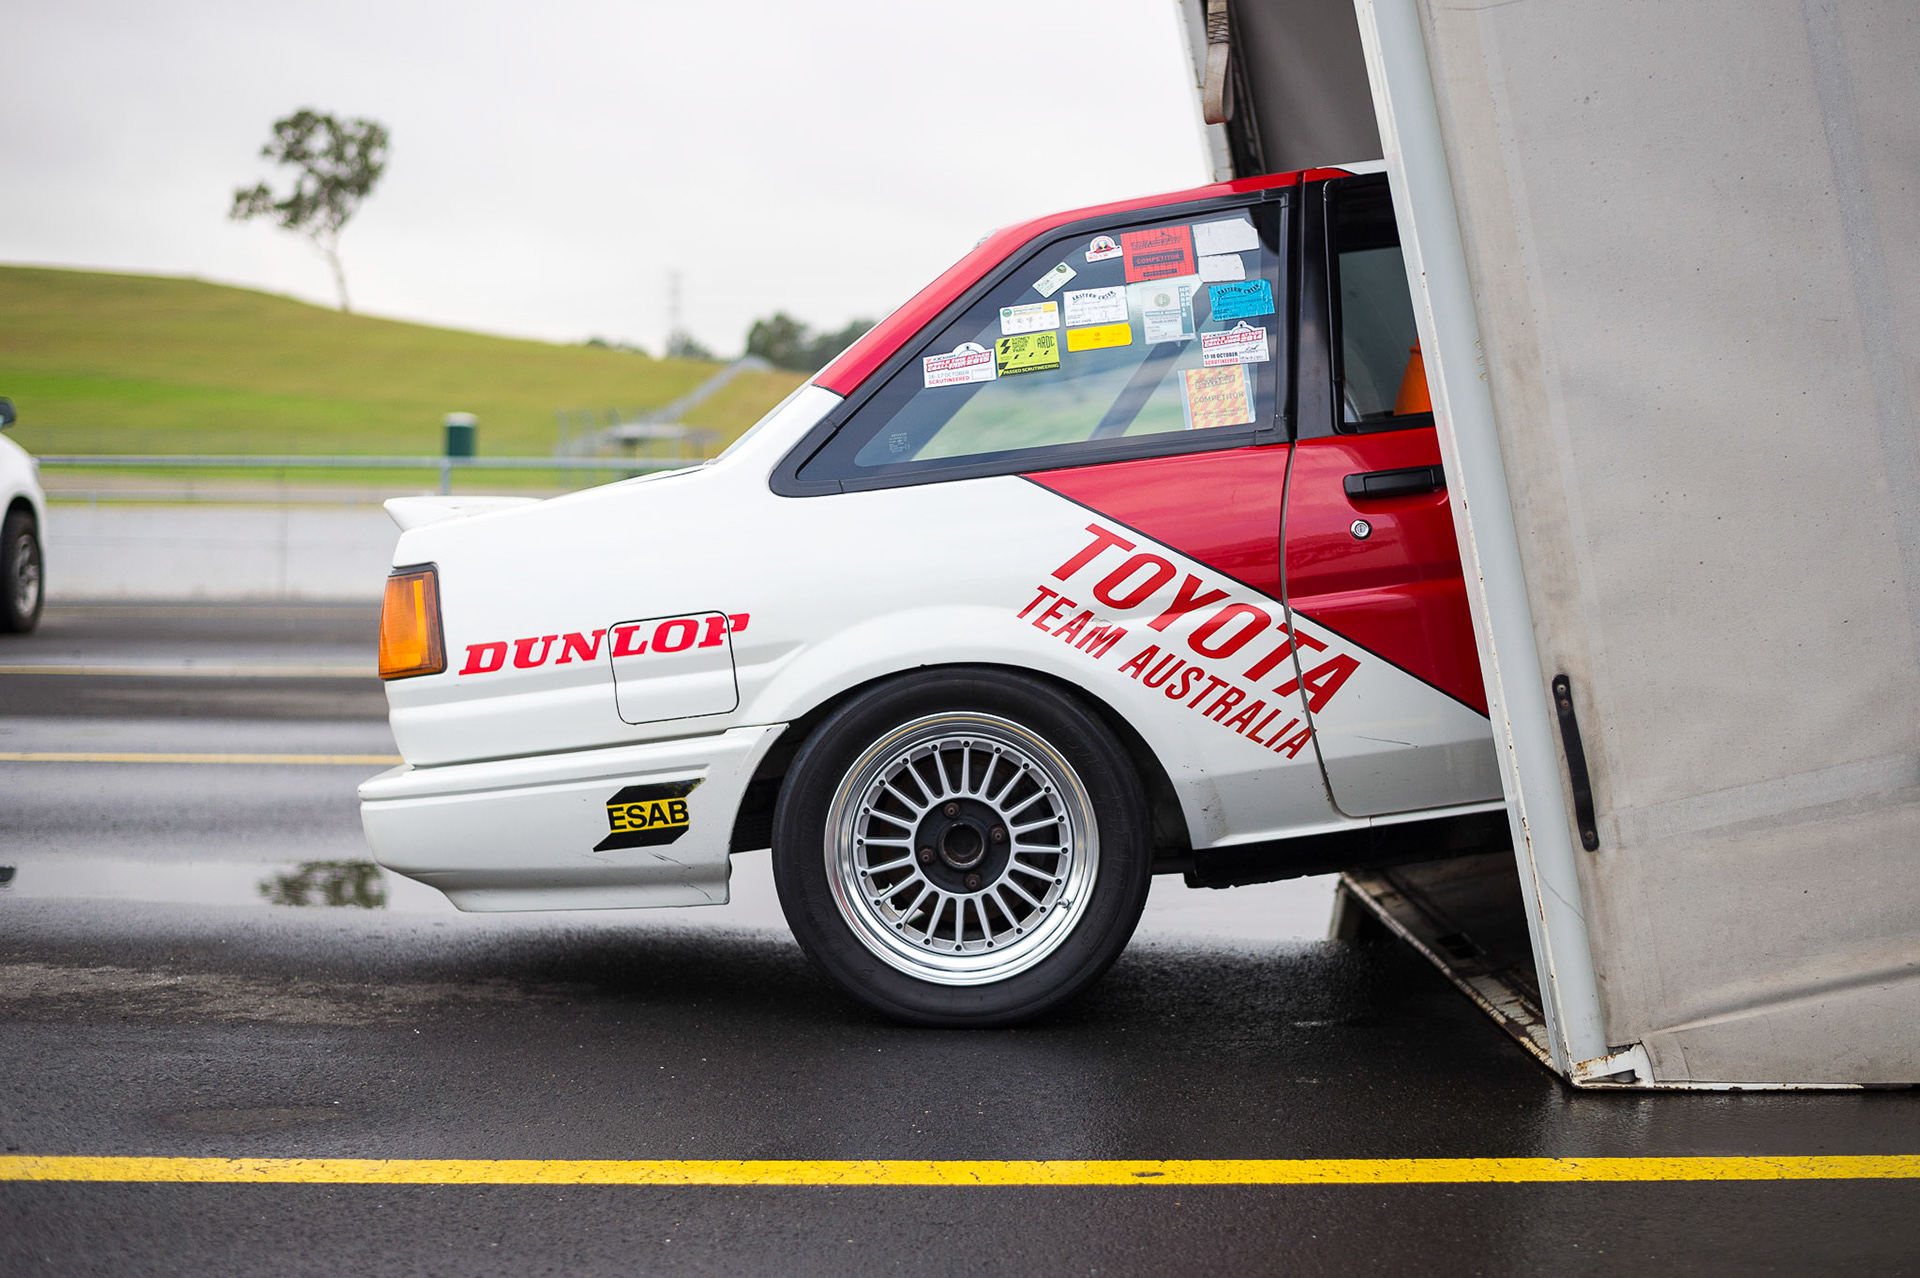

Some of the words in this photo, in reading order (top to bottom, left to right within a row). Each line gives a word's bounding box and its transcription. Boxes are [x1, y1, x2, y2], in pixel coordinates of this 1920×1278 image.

[1136, 254, 1180, 265] COMPETITOR
[1217, 286, 1241, 295] EASTERN
[1071, 292, 1096, 301] EASTERN
[1216, 351, 1238, 359] OCTOBER
[1204, 357, 1239, 366] SCRUTINEERED
[944, 370, 970, 378] OCTOBER
[1003, 368, 1022, 376] PASSED
[1022, 363, 1059, 373] SCRUTINEERING
[928, 375, 971, 385] SCRUTINEERED
[1193, 391, 1244, 404] COMPETITOR
[1050, 523, 1361, 715] TOYOTA
[458, 613, 750, 676] DUNLOP
[1016, 585, 1129, 660] TEAM
[1118, 644, 1317, 760] AUSTRALIA
[607, 799, 690, 831] ESAB
